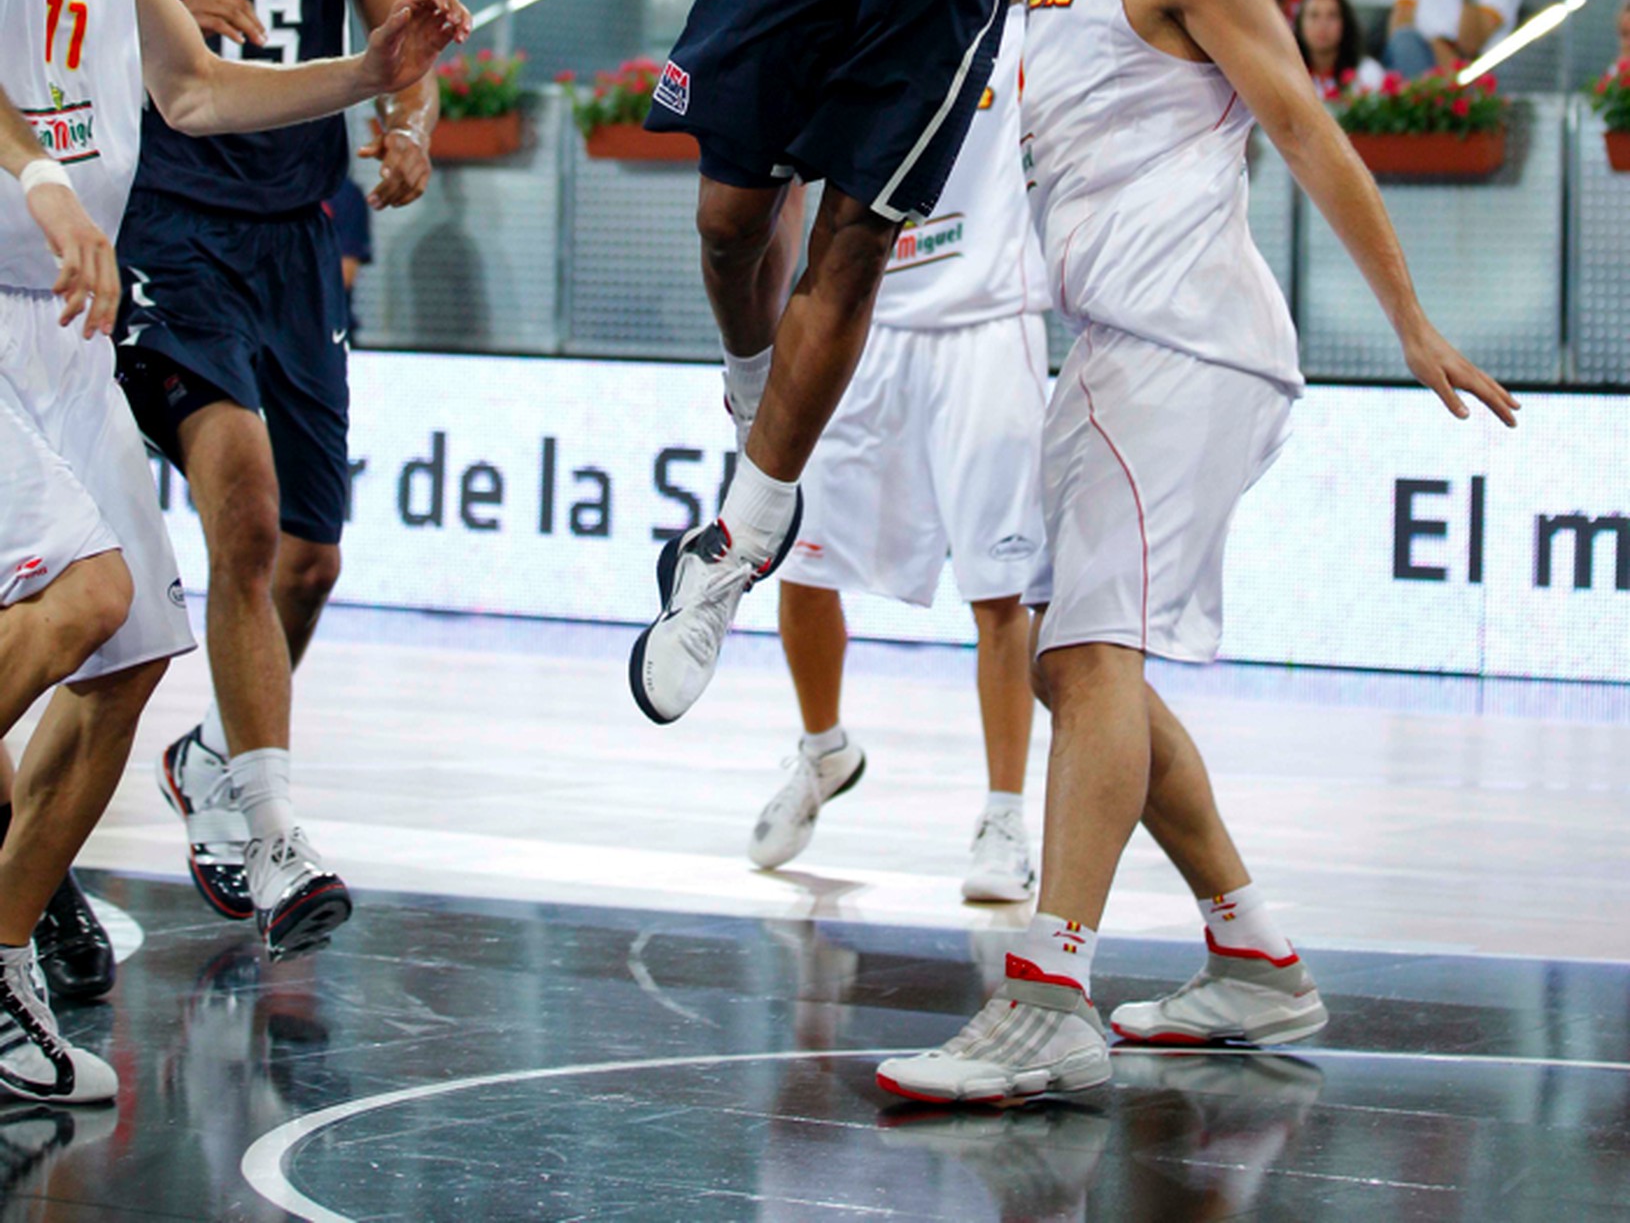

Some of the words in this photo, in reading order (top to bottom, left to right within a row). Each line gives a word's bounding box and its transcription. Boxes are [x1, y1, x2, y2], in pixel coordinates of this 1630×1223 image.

[896, 222, 963, 261] Miguel
[399, 430, 504, 531] de
[540, 436, 611, 537] la
[652, 447, 737, 540] S
[1392, 475, 1486, 584] El
[1533, 511, 1630, 590] m
